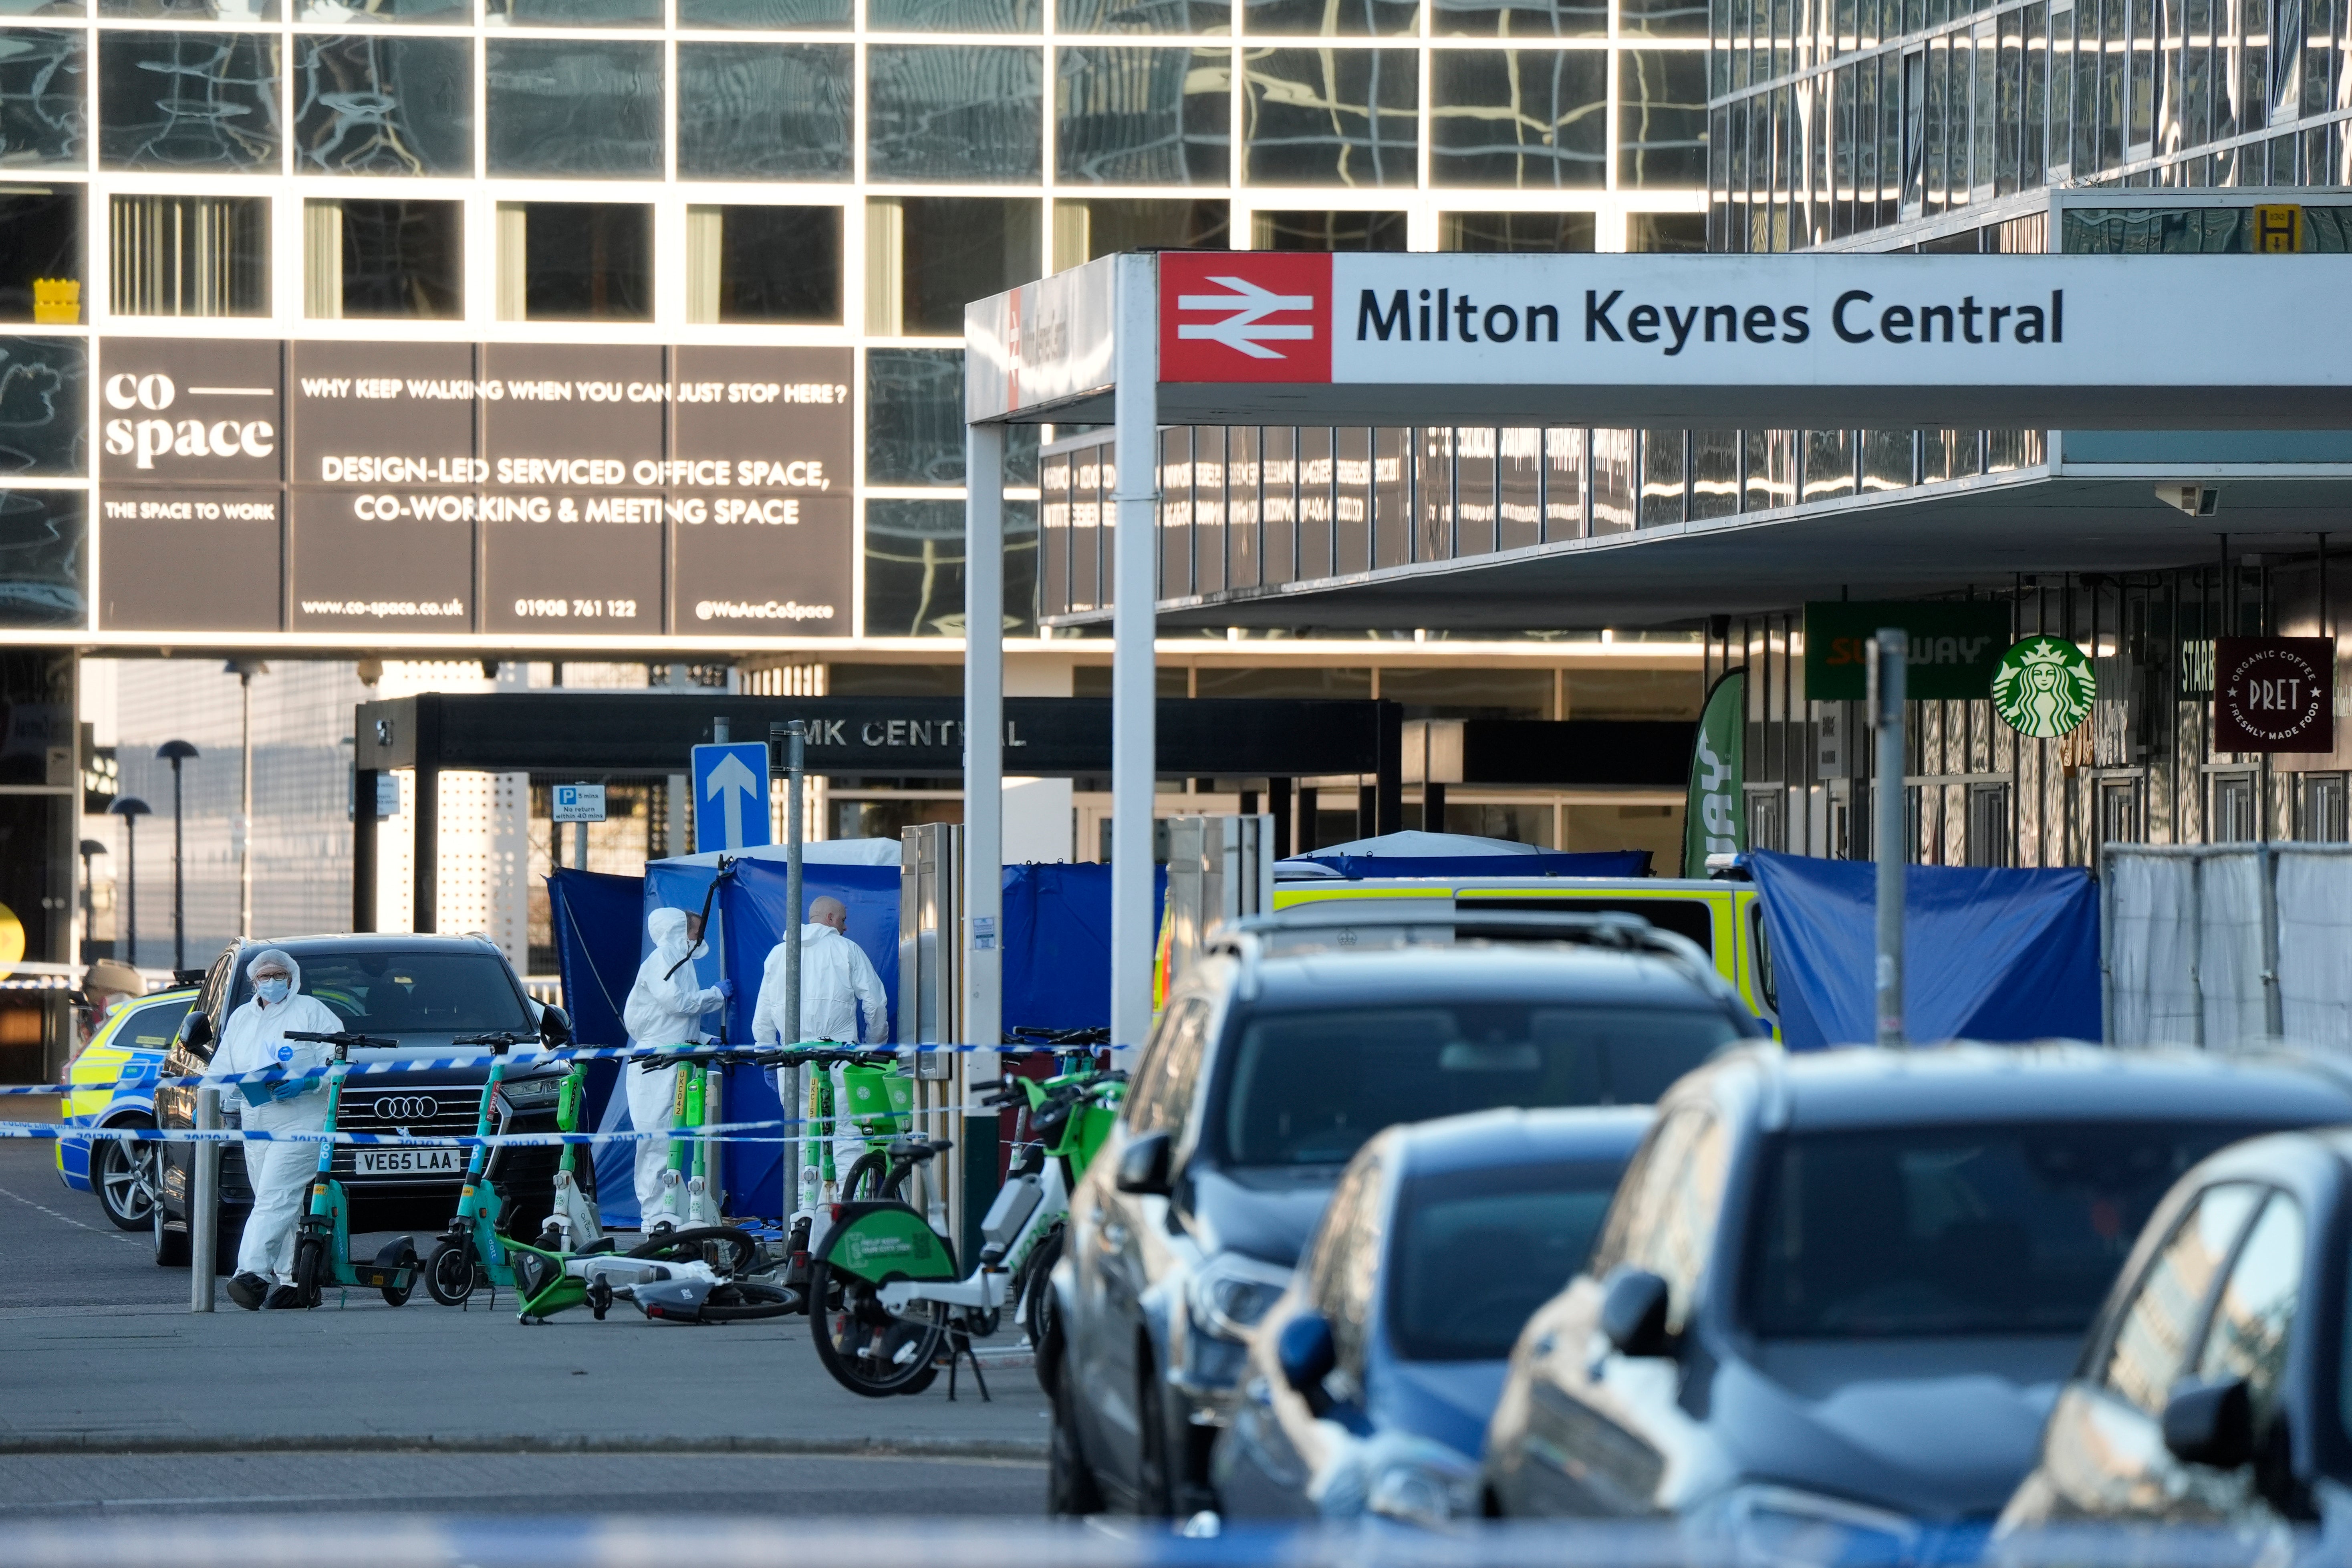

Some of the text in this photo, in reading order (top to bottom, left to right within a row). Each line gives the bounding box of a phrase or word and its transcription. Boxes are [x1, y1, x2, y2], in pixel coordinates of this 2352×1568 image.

[1357, 288, 2063, 356] Milton Keynes Central
[105, 373, 175, 410] co
[301, 378, 847, 403] WHY KEEP WALKING WHEN YOU CAN JUST STOP HERE?
[105, 419, 274, 469] space
[322, 456, 830, 491] DESIGN-LED SERVICED OFFICE SPACE,
[105, 502, 275, 520] THE SPACE TO WORK
[354, 495, 799, 524] CO-WORKING & MEETING SPACE
[301, 598, 464, 618] www.co-space.co.uk
[515, 599, 636, 617] 01908 761 122
[695, 600, 834, 622] @WeAreCoSpace
[1826, 636, 1992, 665] SUWAY
[2232, 650, 2316, 682] ORGANIC COFFEE
[2249, 679, 2300, 710] PRET
[802, 720, 1026, 747] MK CENTL
[2229, 703, 2266, 738] FRESHLY
[2268, 730, 2299, 740] MADE
[2299, 702, 2319, 728] FOOD
[676, 1071, 685, 1115] UKC042
[364, 1152, 452, 1171] VE65 LAA
[489, 1239, 497, 1259] dott
